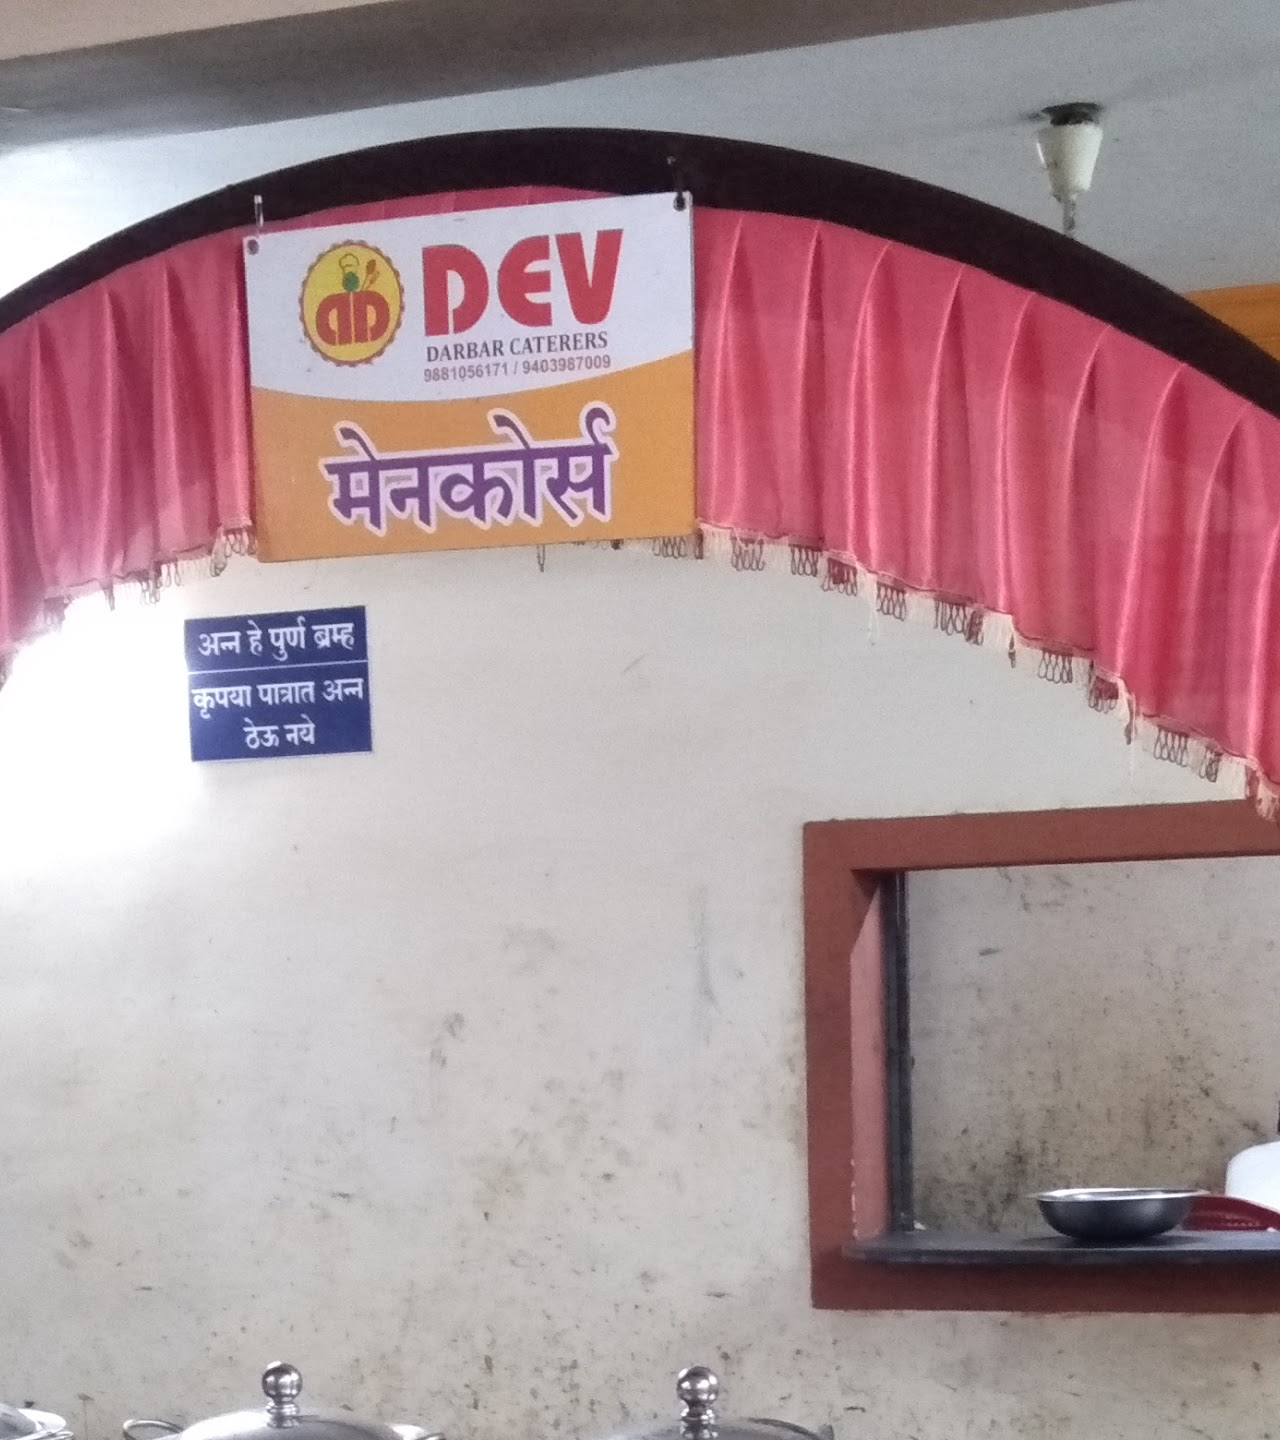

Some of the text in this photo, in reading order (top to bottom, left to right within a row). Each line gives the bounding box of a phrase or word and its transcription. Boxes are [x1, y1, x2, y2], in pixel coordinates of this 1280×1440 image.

[422, 228, 624, 336] DEV
[426, 331, 609, 362] DARBAR CATERERS
[423, 362, 509, 383] 9881056171
[522, 354, 612, 375] 9403987009
[322, 405, 616, 533] मेनकोर्स
[198, 631, 242, 657] अन्न
[246, 619, 264, 657] हे
[267, 615, 307, 662] पुर्ण
[191, 677, 365, 720] कृपया पात्रात अन्न
[242, 713, 317, 750] ठेऊ नये
